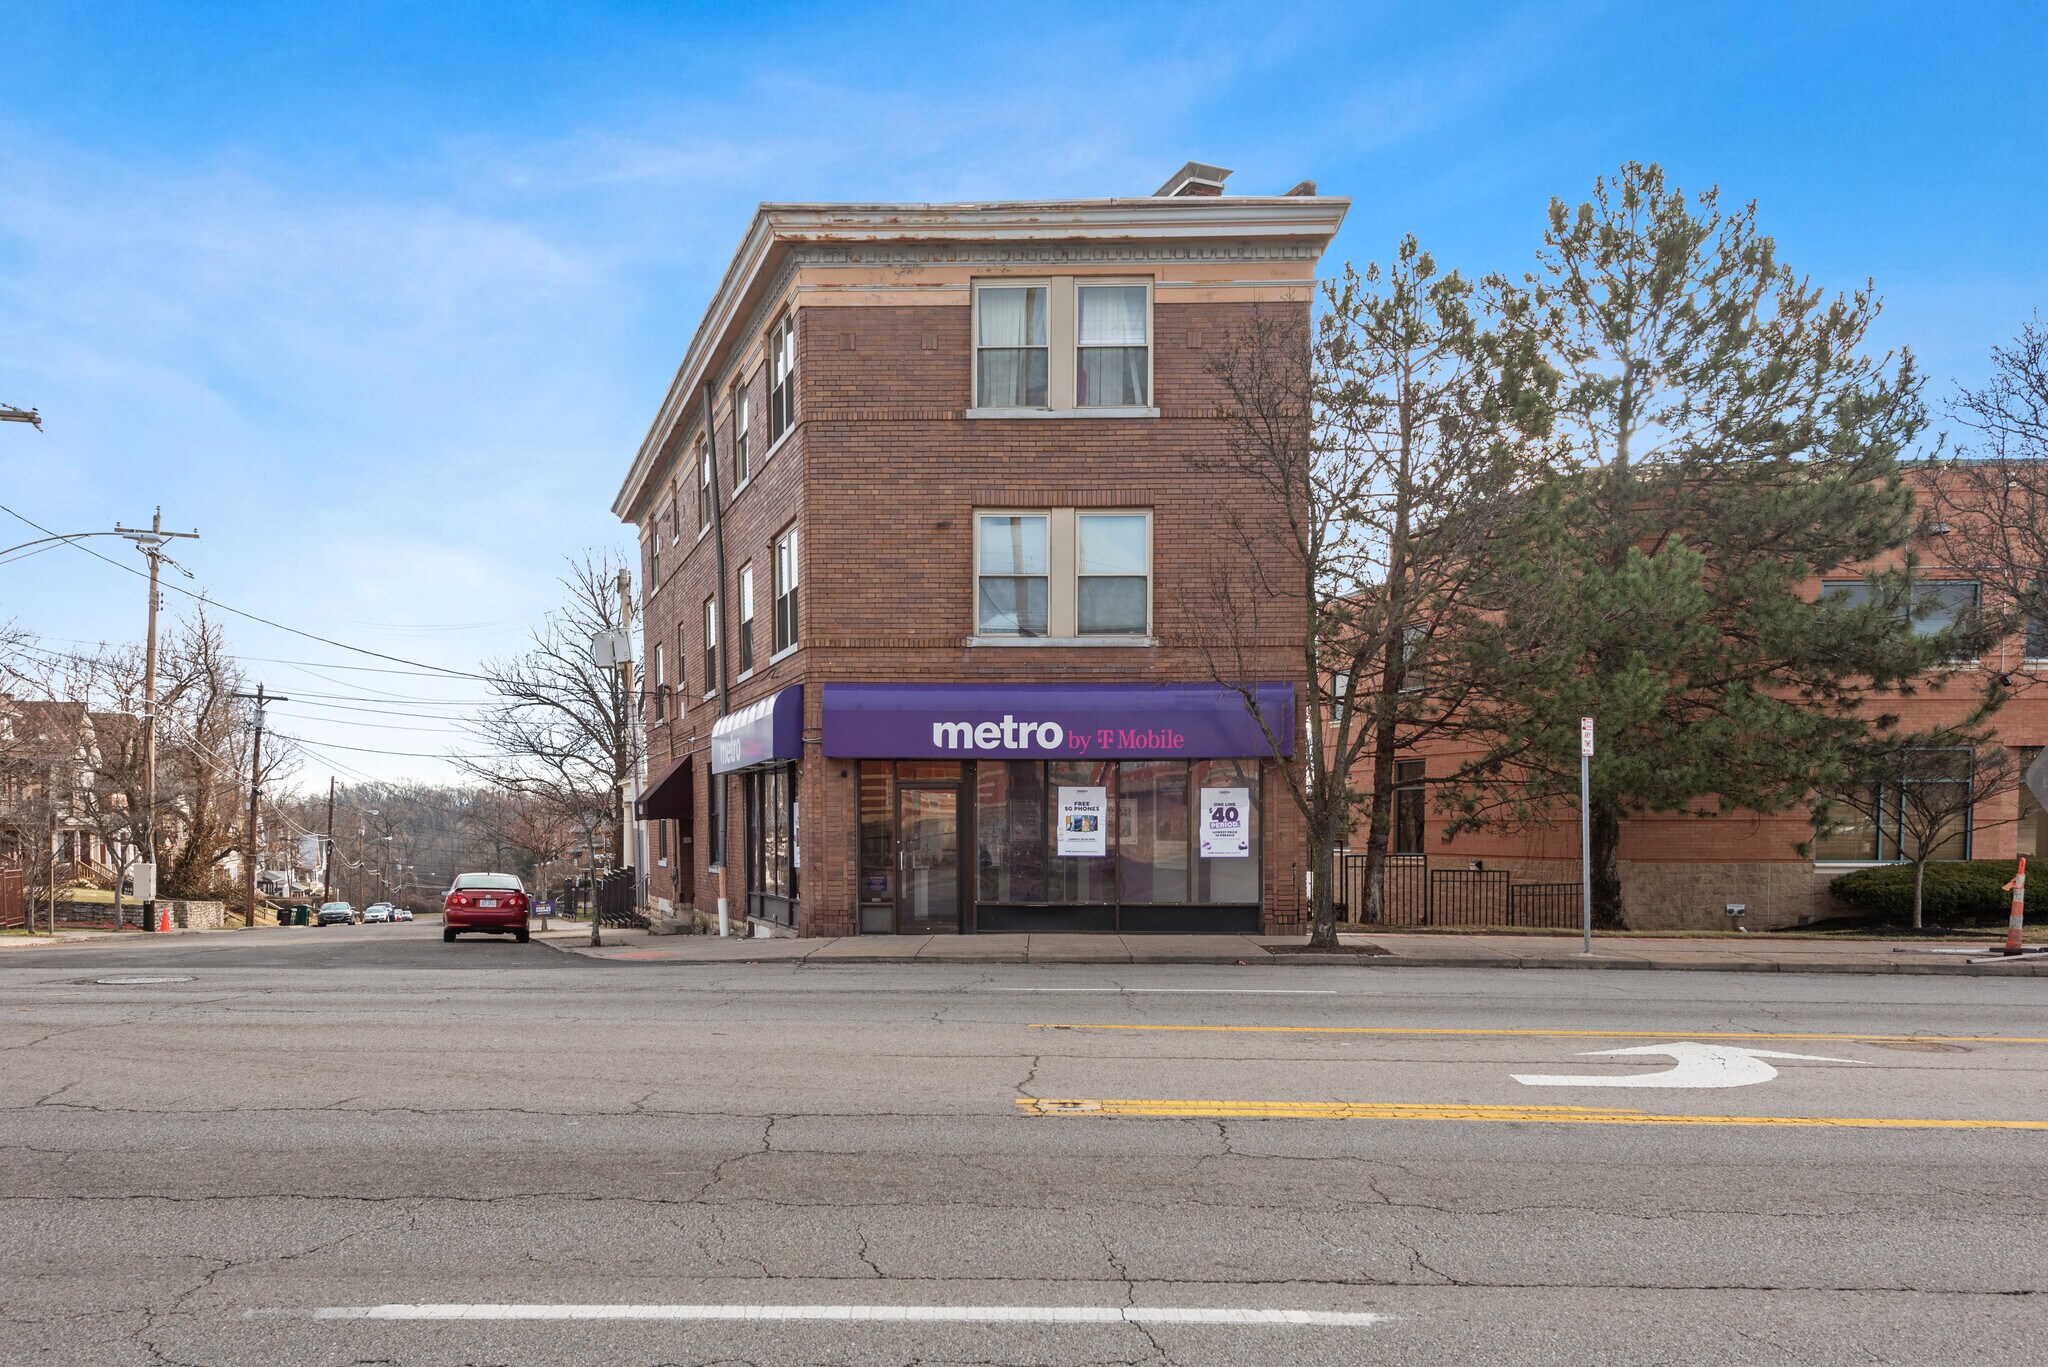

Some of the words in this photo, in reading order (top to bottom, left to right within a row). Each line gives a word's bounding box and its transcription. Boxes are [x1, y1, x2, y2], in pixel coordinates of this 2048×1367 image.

[720, 734, 741, 765] metro
[933, 715, 1064, 750] metro
[1068, 730, 1091, 754] by
[1118, 729, 1184, 749] Mobile
